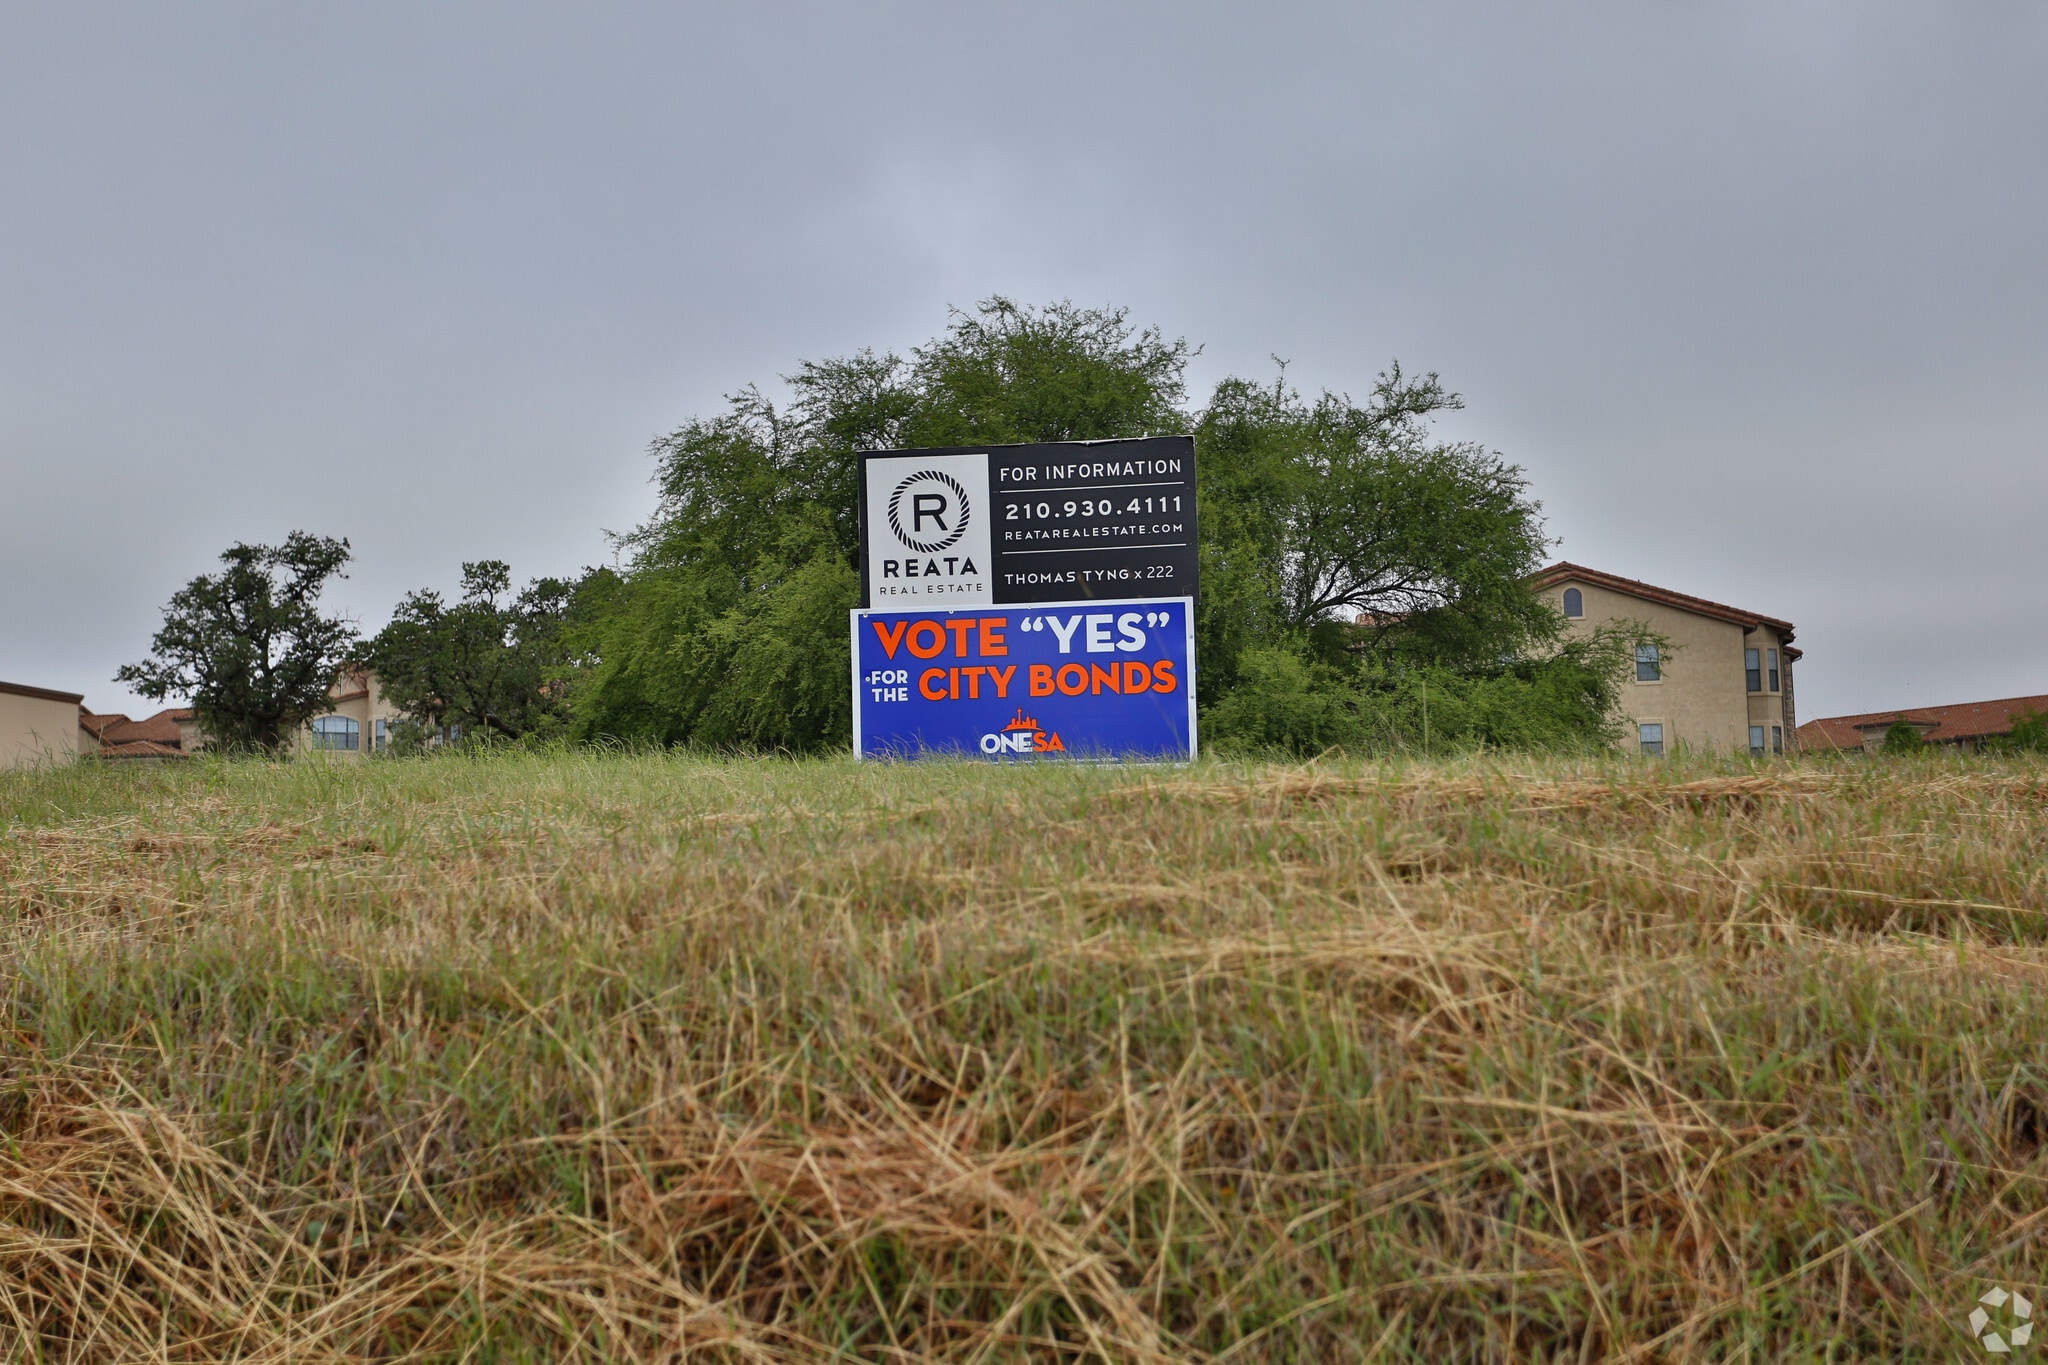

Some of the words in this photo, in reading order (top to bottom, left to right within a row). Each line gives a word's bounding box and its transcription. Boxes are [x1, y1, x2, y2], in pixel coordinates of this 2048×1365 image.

[1000, 466, 1037, 482] FOR
[1046, 459, 1182, 481] INFORMATION
[913, 494, 948, 532] R
[1005, 496, 1182, 520] 210.930.4111
[1005, 523, 1183, 541] REATAREALESTATE.COM
[883, 557, 978, 578] REATA
[1004, 571, 1077, 585] THOMAS
[1083, 569, 1130, 581] TYNG
[1146, 565, 1174, 579] 222
[880, 586, 918, 596] REAL
[927, 583, 983, 594] ESTATE
[872, 617, 1008, 660] VOTE
[1020, 612, 1170, 654] “YES”
[871, 670, 908, 685] FOR
[918, 665, 1017, 701] CITY
[1029, 659, 1178, 697] BONDS
[872, 687, 908, 702] THE
[980, 731, 1066, 754] ONESA
